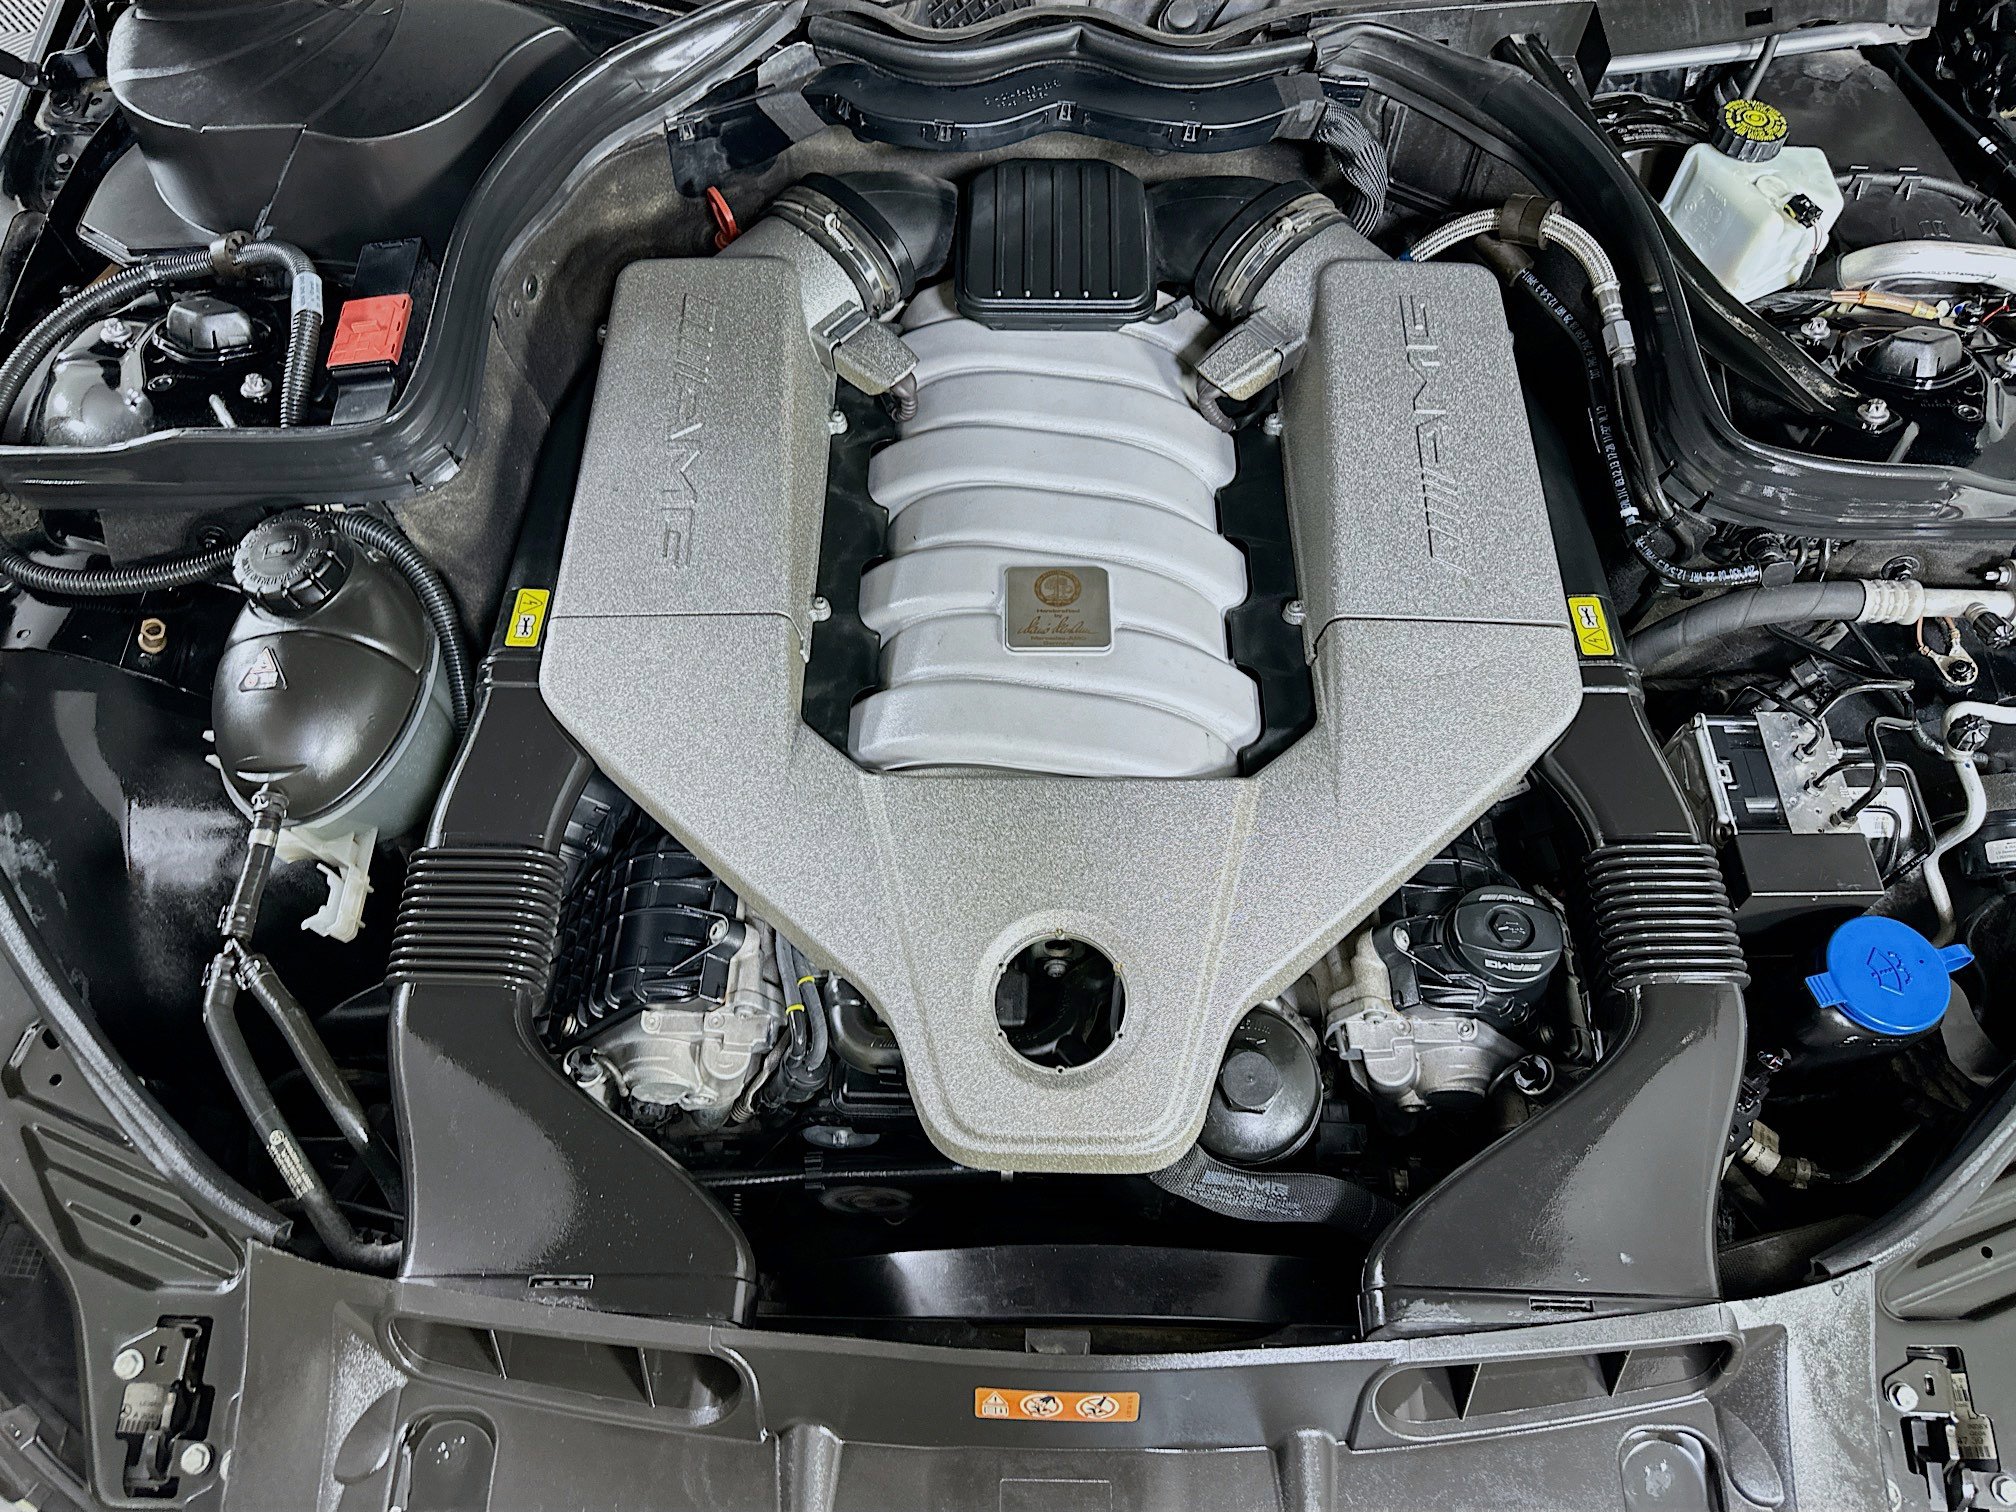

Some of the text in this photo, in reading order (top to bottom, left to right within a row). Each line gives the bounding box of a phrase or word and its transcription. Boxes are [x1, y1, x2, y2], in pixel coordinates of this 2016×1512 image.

[1554, 304, 1567, 317] VRT
[1562, 313, 1574, 325] 29
[1689, 571, 1704, 583] VRT
[1706, 571, 1715, 583] 29
